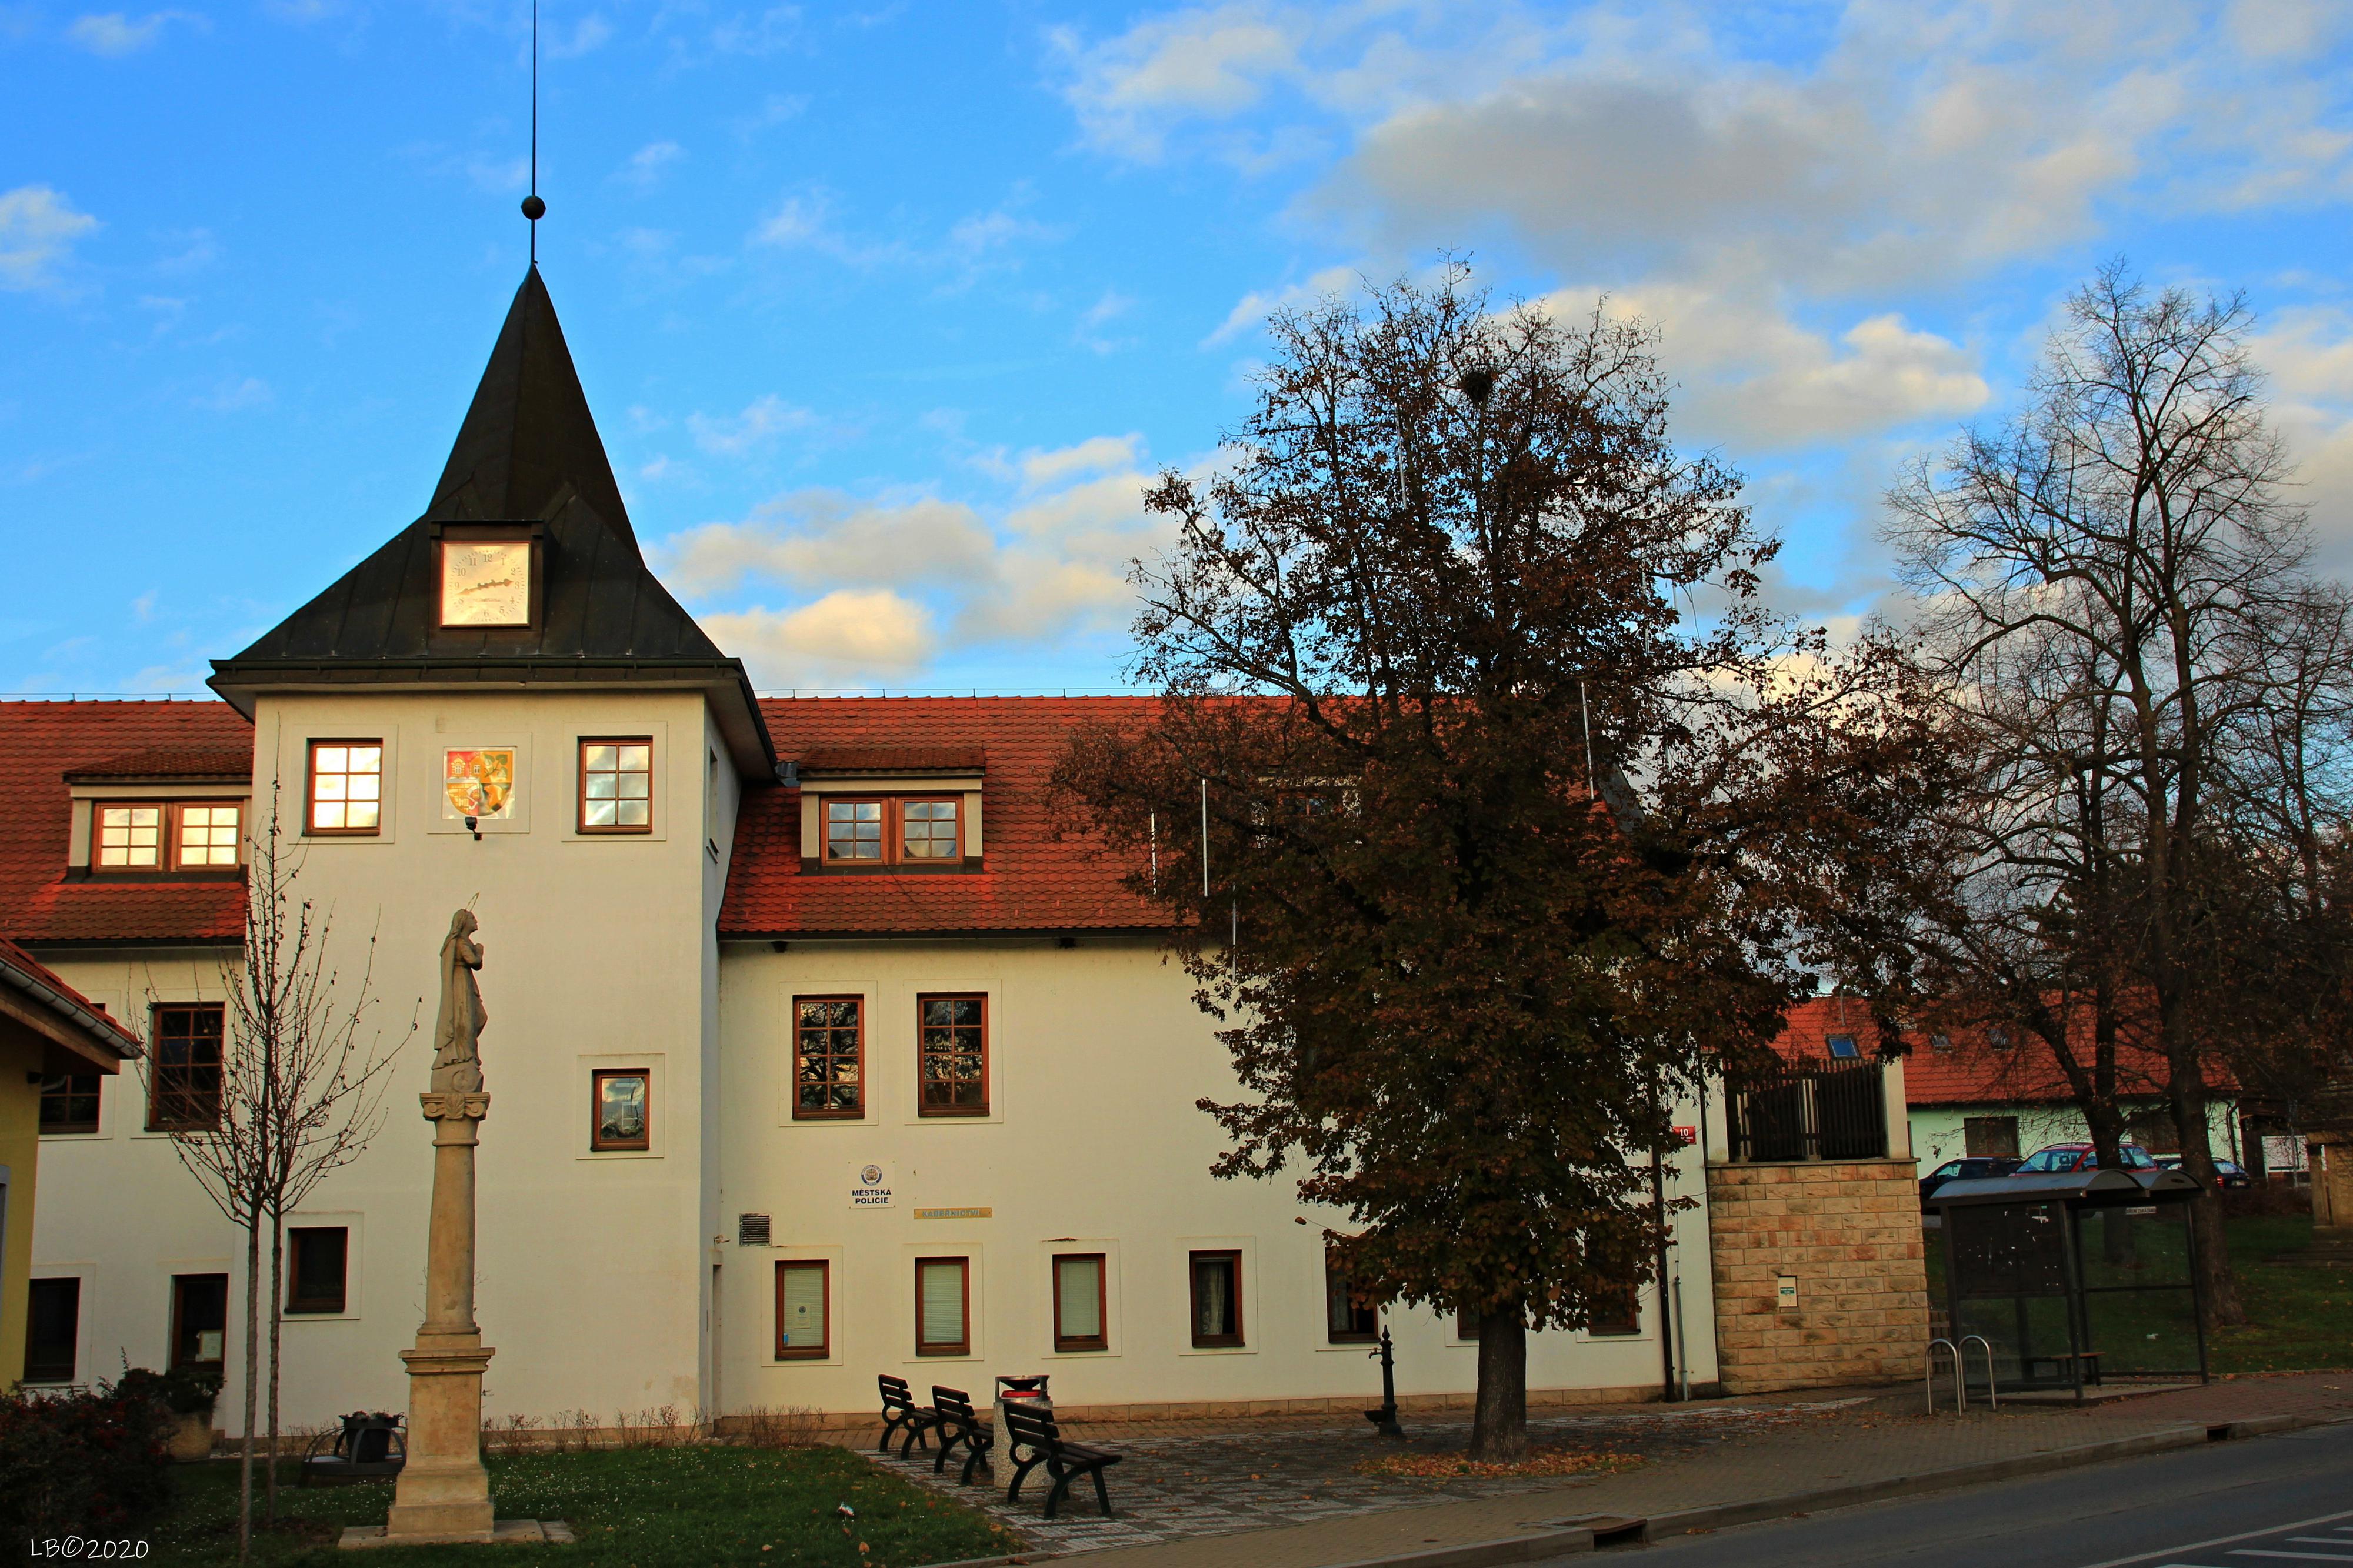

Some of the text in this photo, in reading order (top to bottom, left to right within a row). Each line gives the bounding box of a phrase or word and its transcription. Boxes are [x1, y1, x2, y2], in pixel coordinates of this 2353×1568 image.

[483, 553, 492, 562] 12
[469, 558, 477, 566] 11
[457, 568, 466, 576] 10
[511, 568, 516, 576] 2
[515, 581, 520, 589] 3
[499, 606, 504, 614] 5
[1679, 1128, 1689, 1136] 10
[852, 1187, 891, 1196] MĚSTSKÁ
